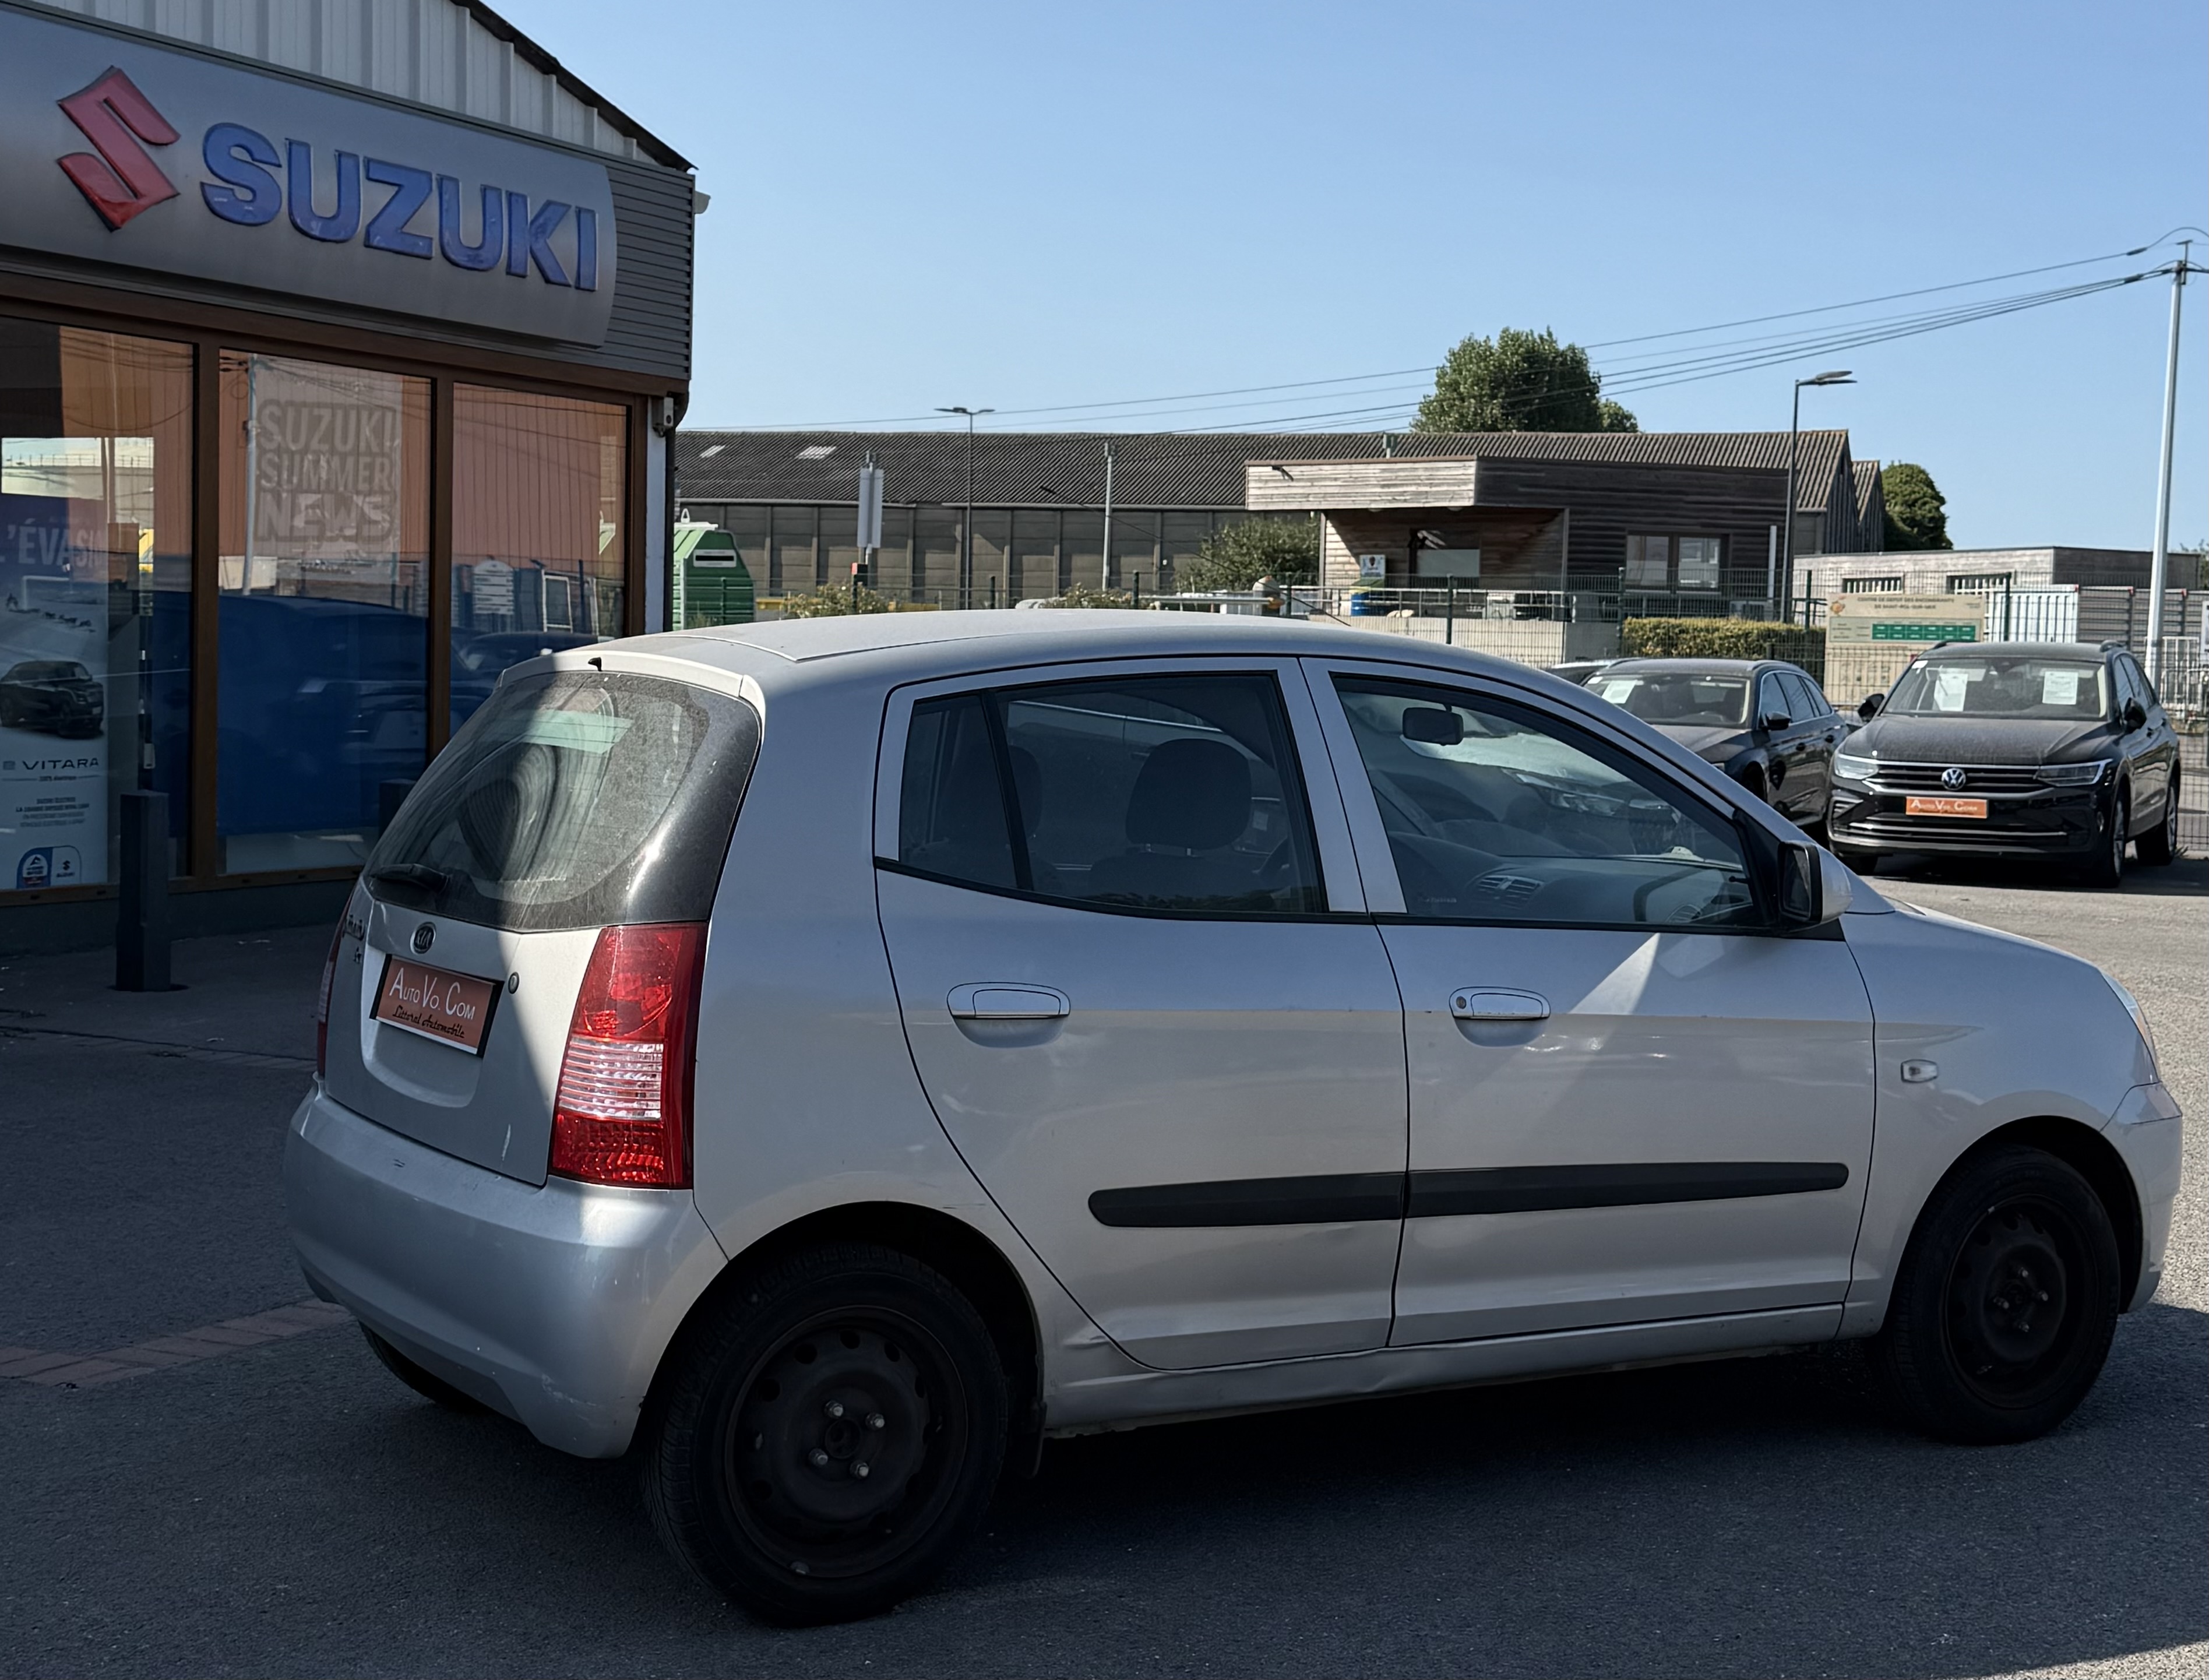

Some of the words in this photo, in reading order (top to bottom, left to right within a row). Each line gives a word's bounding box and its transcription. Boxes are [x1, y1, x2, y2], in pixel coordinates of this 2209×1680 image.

[199, 121, 599, 291] SUZUKI
[261, 404, 393, 453] SUZUKI
[261, 452, 391, 492] SUMMER
[257, 492, 391, 537] NEWS
[22, 758, 100, 770] VITARA
